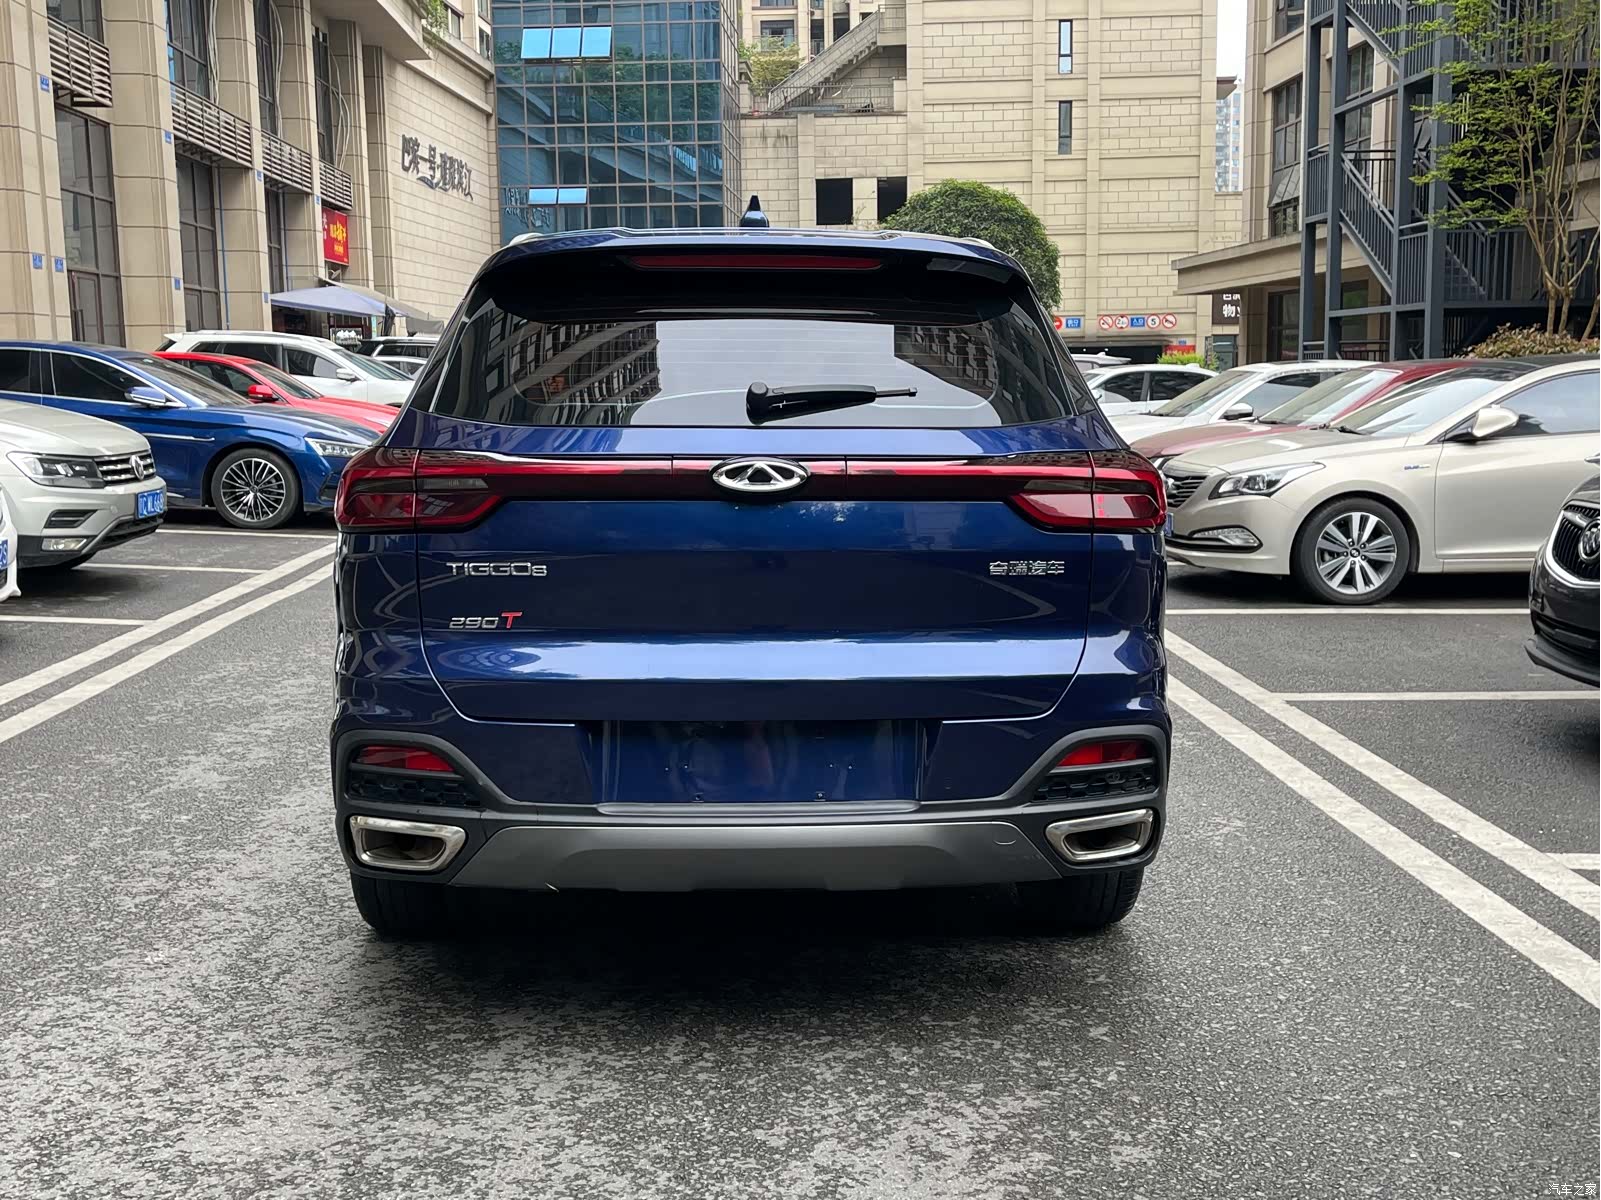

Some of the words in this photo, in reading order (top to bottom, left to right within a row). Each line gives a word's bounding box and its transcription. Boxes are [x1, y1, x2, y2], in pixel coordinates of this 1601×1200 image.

[1150, 317, 1157, 326] 5
[989, 560, 1065, 576] 奇瑞汽车
[448, 611, 523, 629] 290T
